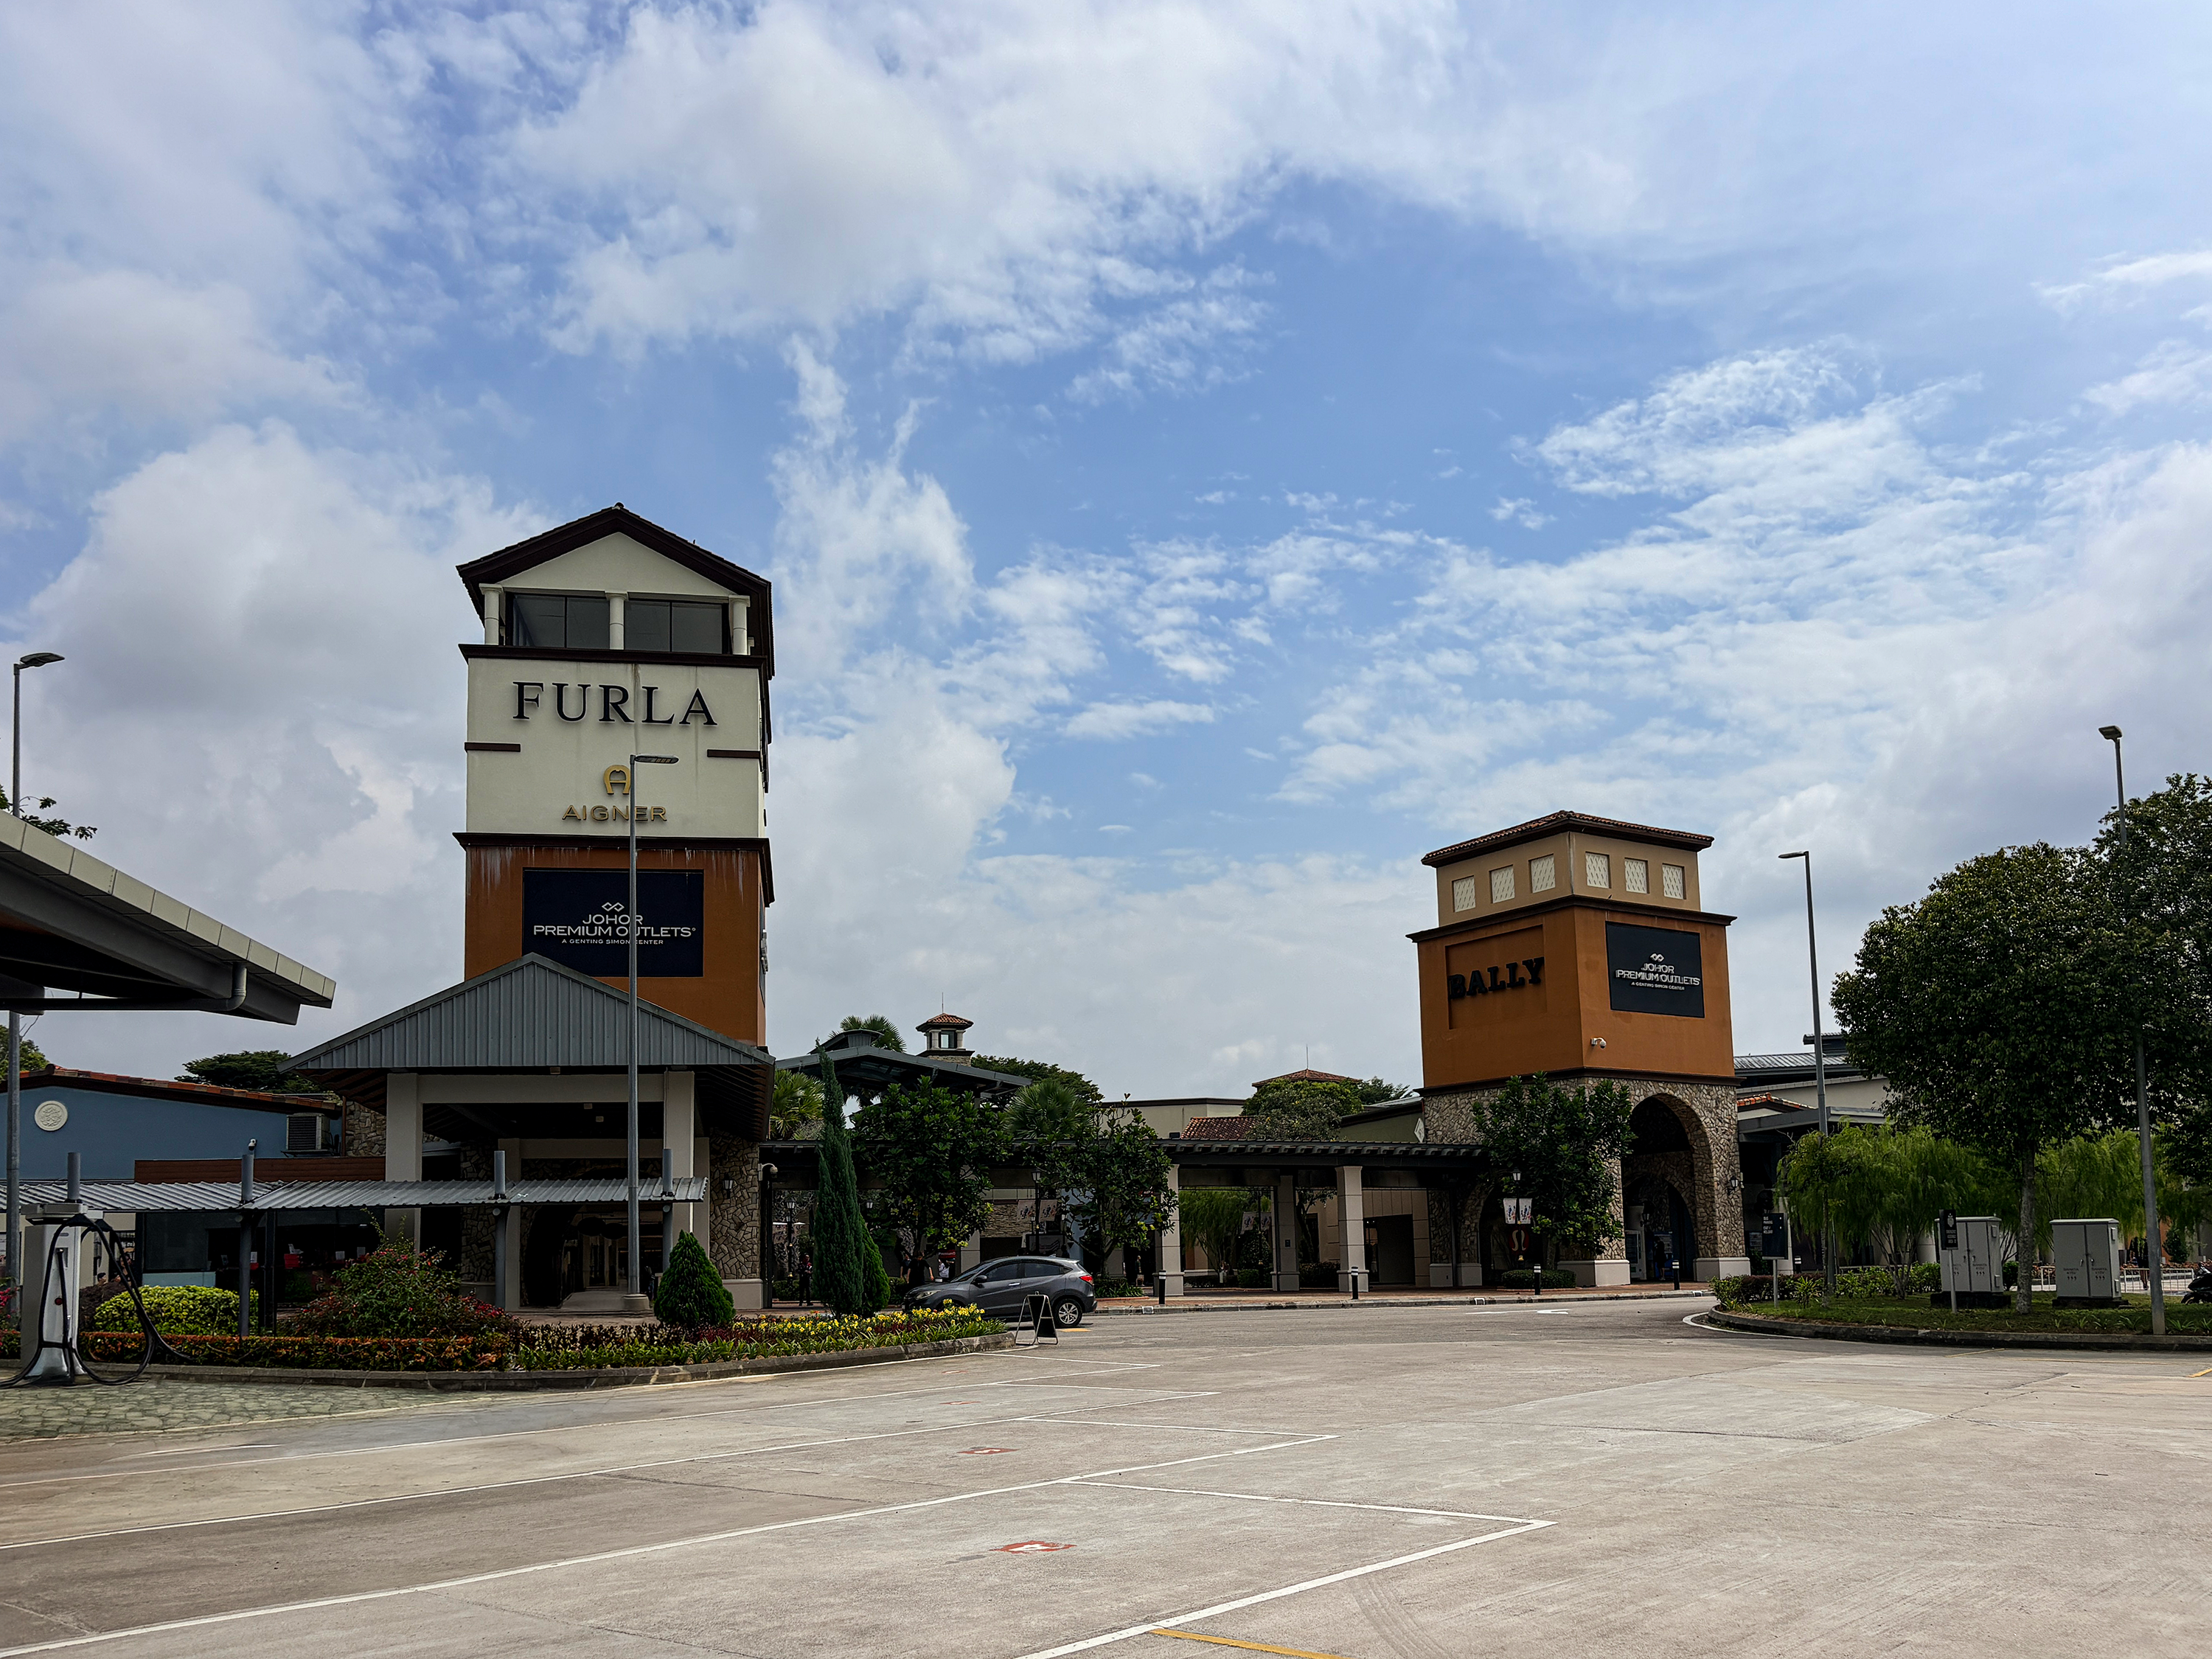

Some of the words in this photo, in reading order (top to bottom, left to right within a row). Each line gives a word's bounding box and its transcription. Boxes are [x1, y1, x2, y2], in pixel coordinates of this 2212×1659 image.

[512, 681, 718, 726] FURLA
[562, 804, 667, 821] AIGNER
[582, 914, 644, 925] JOHOR
[533, 925, 612, 936] PREMIUM
[1641, 963, 1674, 973] JOHOR
[1447, 956, 1545, 1000] BALLY
[1615, 970, 1659, 982] PREMIUM
[1660, 974, 1700, 985] OUTLETS
